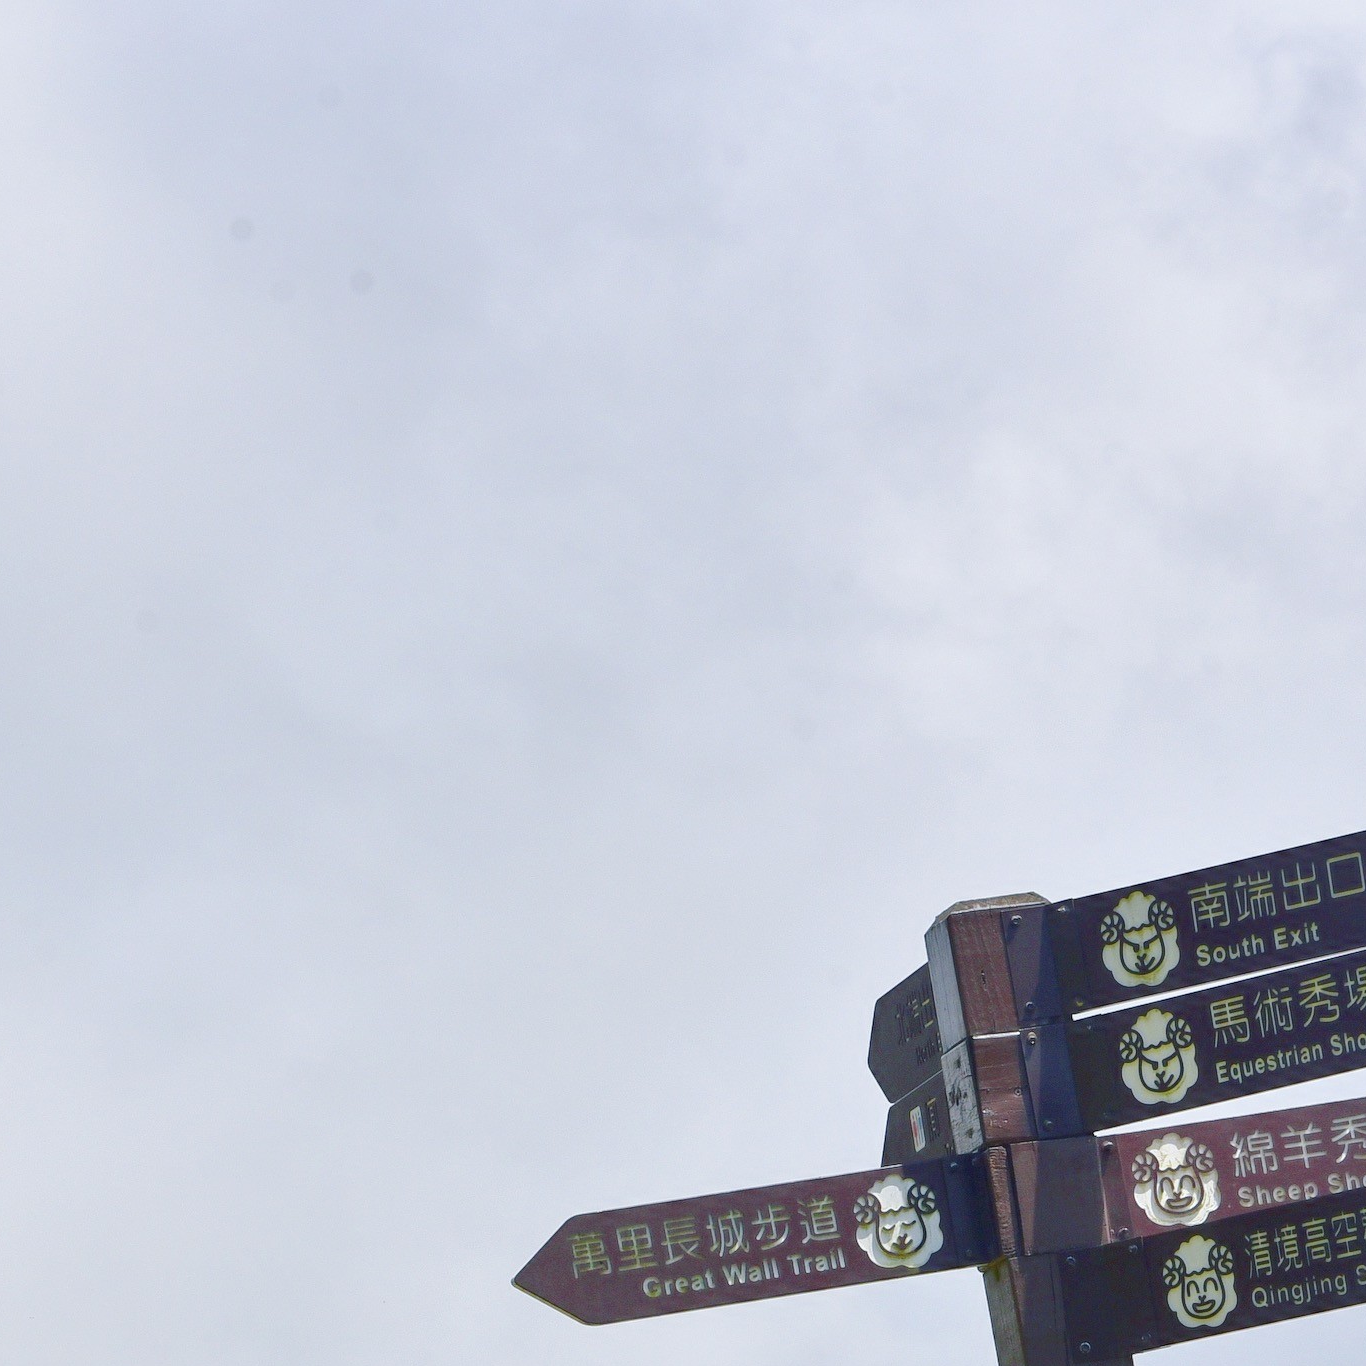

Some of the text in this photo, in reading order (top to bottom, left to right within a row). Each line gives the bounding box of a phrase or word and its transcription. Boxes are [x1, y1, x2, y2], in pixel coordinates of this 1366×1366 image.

[1187, 851, 1366, 933] 南端出口
[1196, 921, 1320, 967] South Exit
[1215, 1042, 1324, 1084] Equestrian
[1237, 1181, 1319, 1208] Sheep
[567, 1195, 841, 1279] 萬里長城步道
[642, 1247, 846, 1298] Great Wall Trail
[1251, 1273, 1348, 1309] Qingjing
